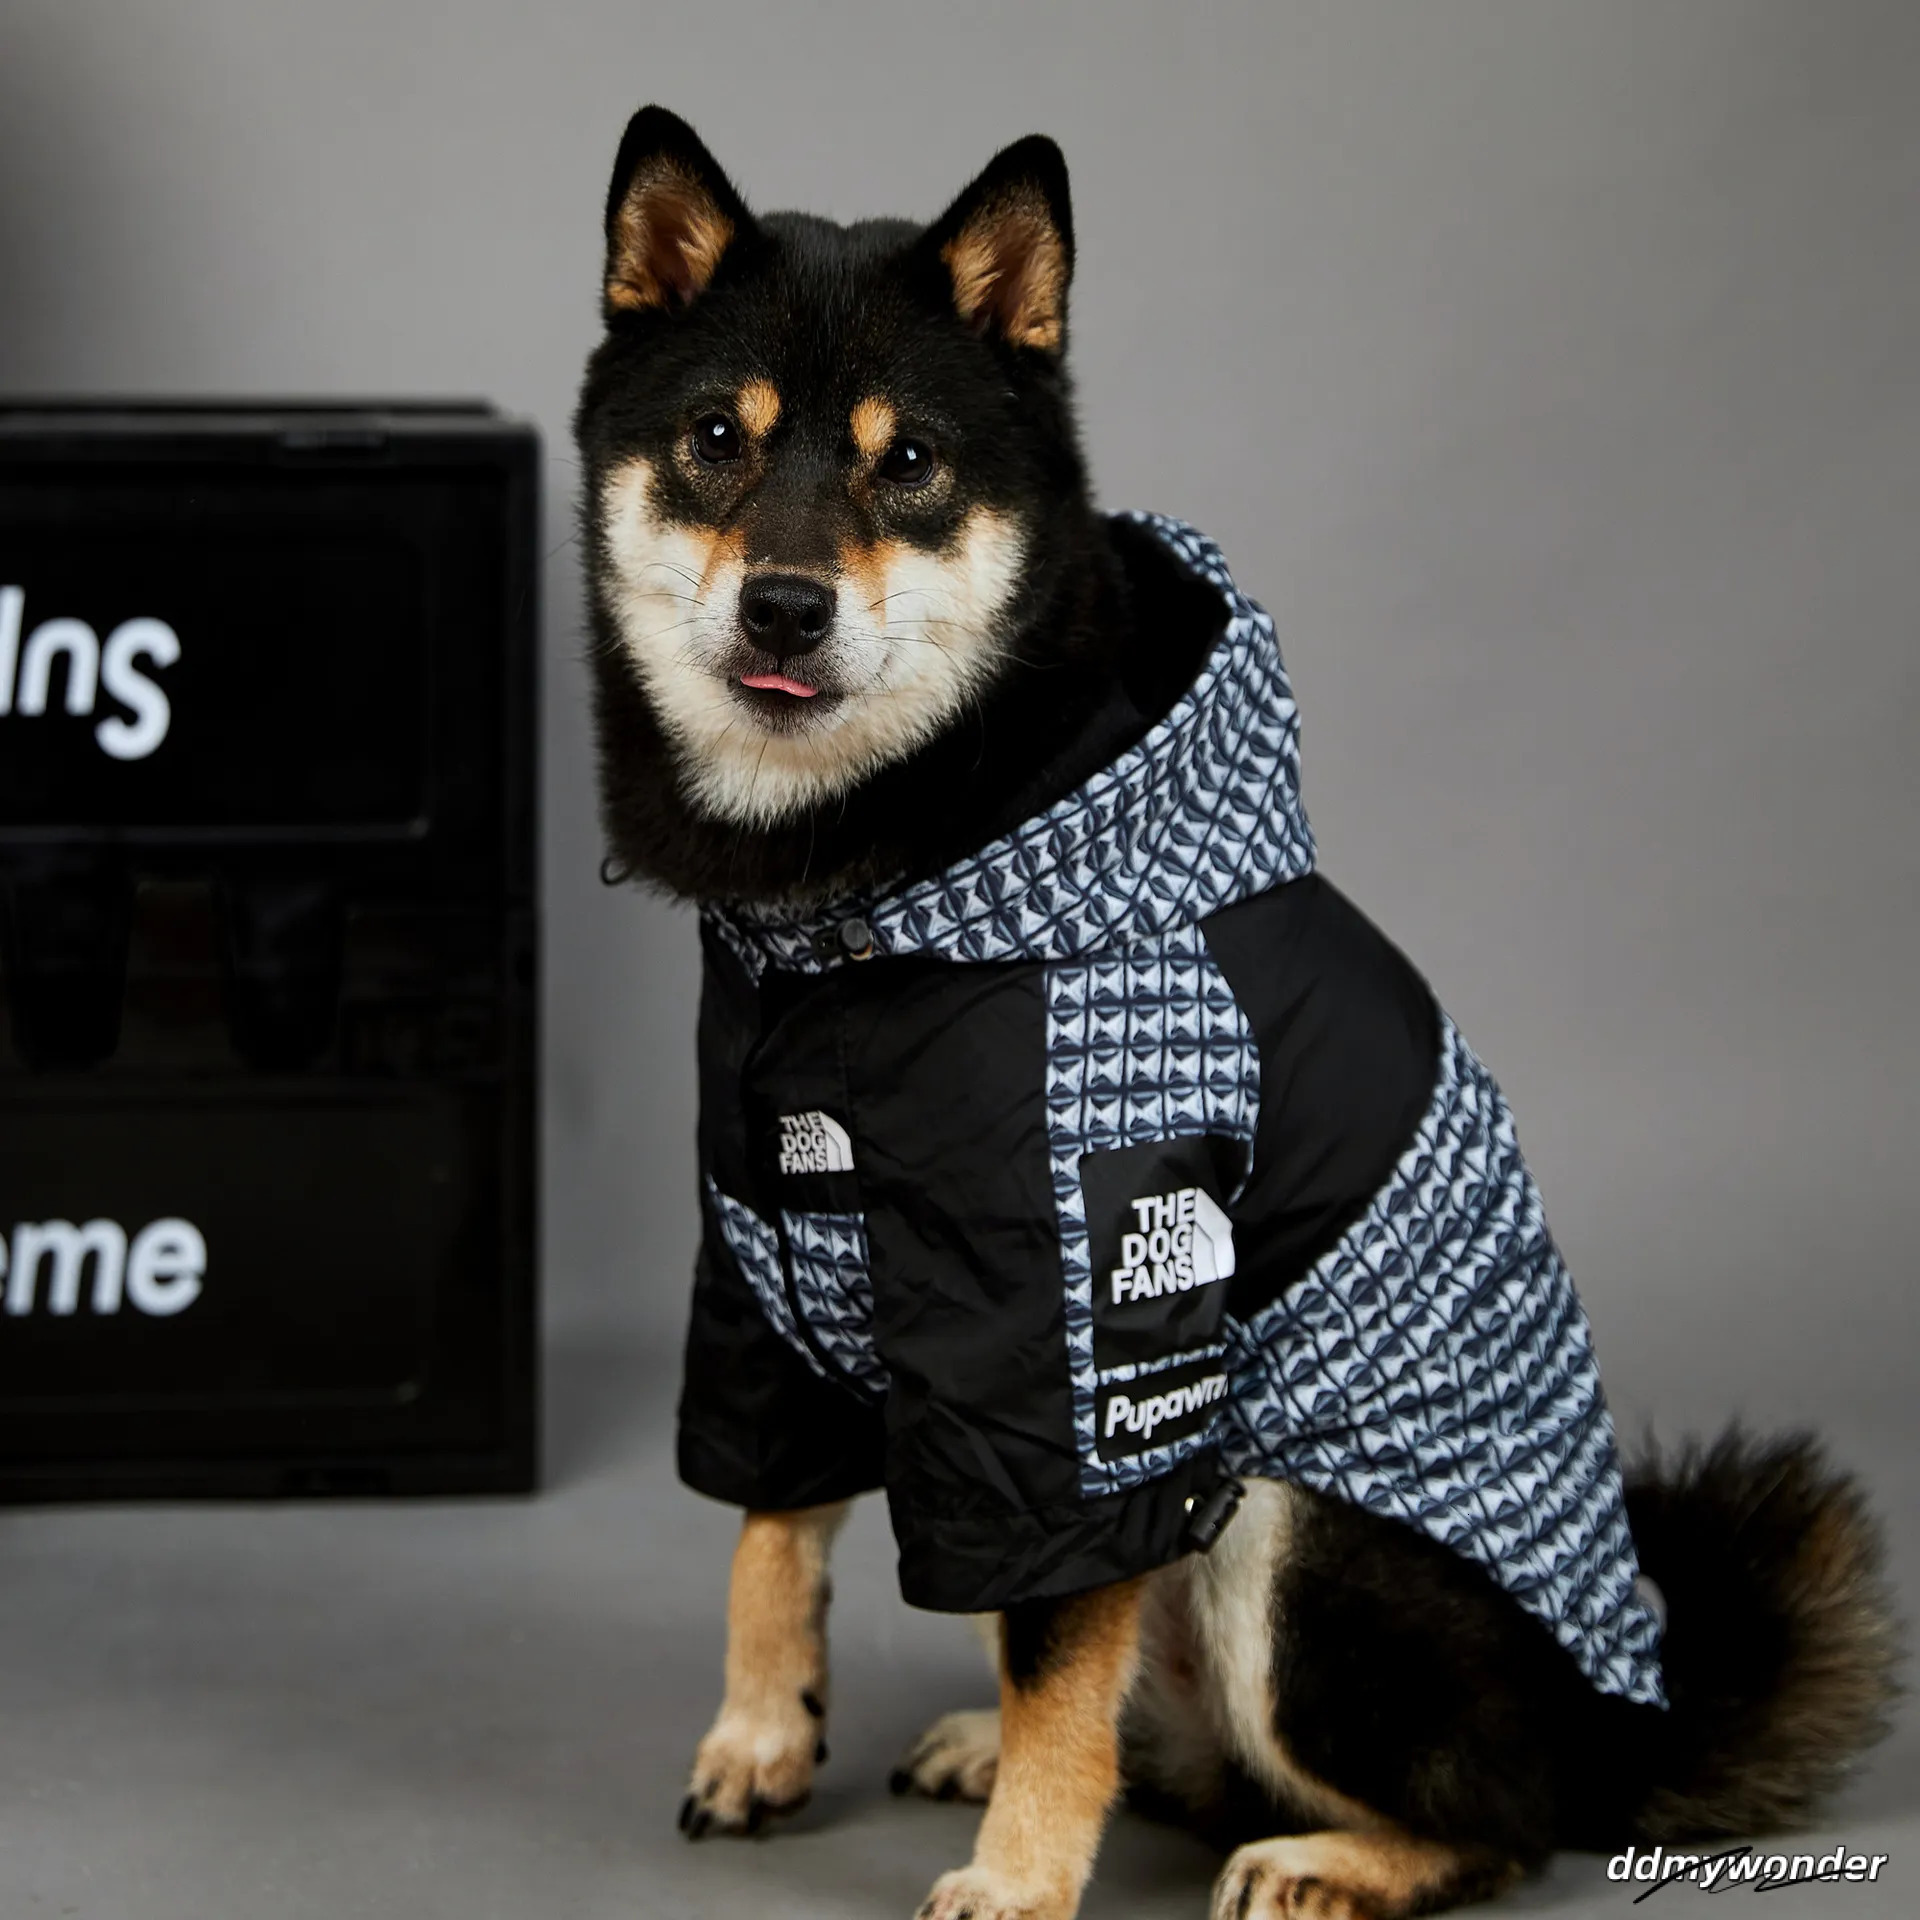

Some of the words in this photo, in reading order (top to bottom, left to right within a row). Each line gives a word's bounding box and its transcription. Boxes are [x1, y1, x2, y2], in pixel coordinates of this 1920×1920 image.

[780, 1111, 821, 1133] THE
[781, 1130, 826, 1154] DOG
[780, 1151, 827, 1175] FANS
[1131, 1188, 1197, 1233] THE
[1122, 1223, 1194, 1269] DOG
[1111, 1255, 1195, 1305] FANS
